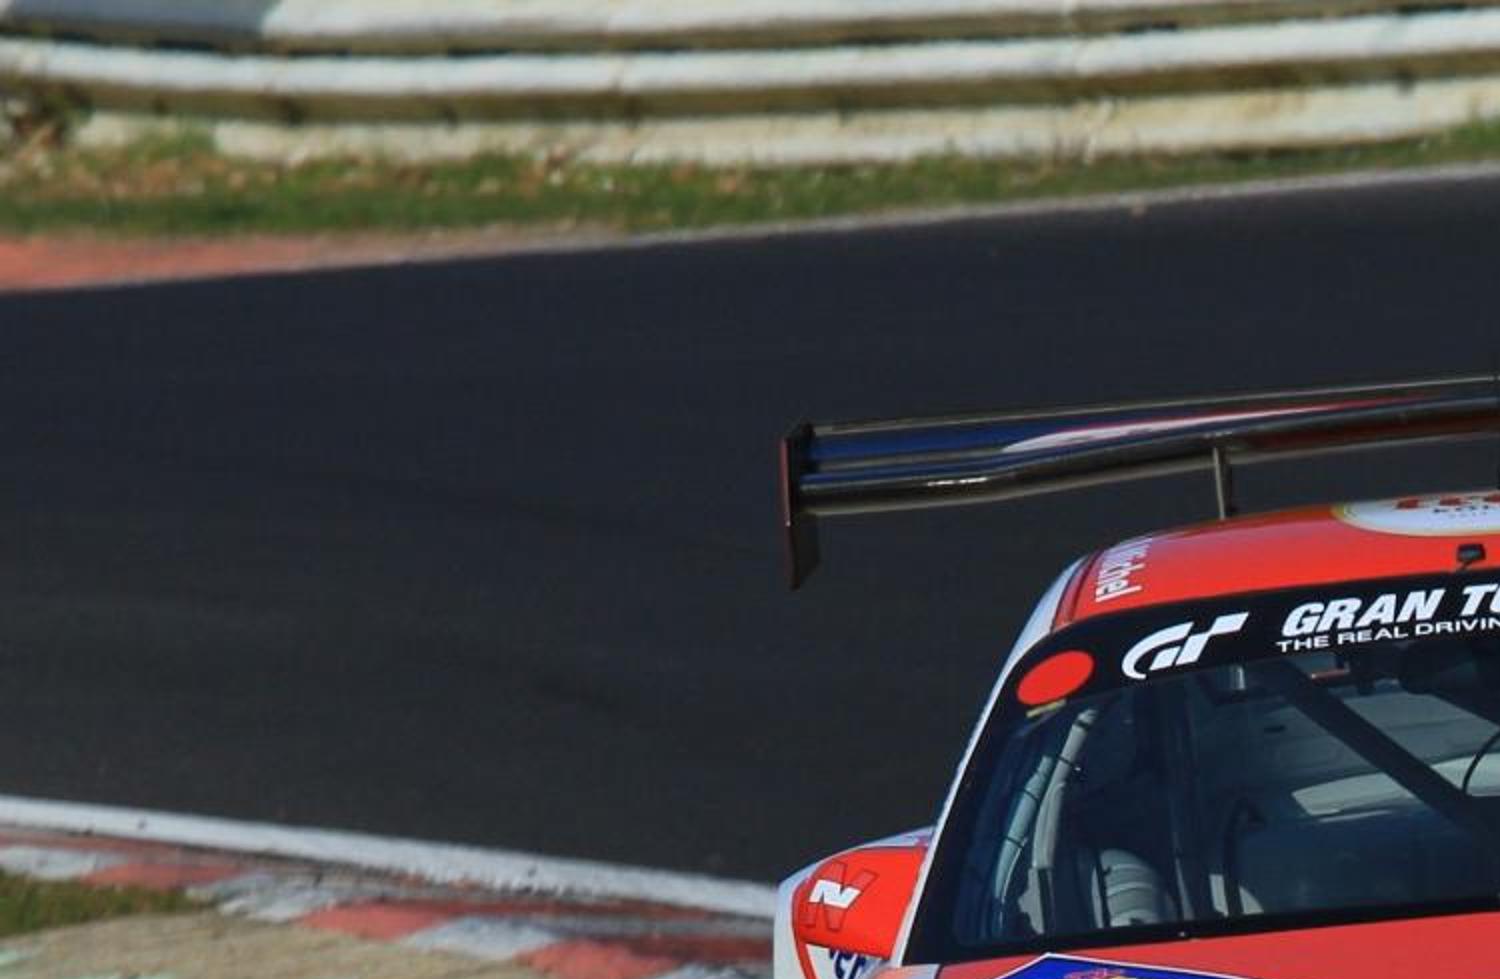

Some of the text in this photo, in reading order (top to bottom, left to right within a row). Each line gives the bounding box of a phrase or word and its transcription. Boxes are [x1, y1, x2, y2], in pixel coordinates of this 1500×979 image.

[1282, 589, 1445, 637] GRAN
[1276, 636, 1328, 652] THE
[1338, 628, 1408, 645] REAL
